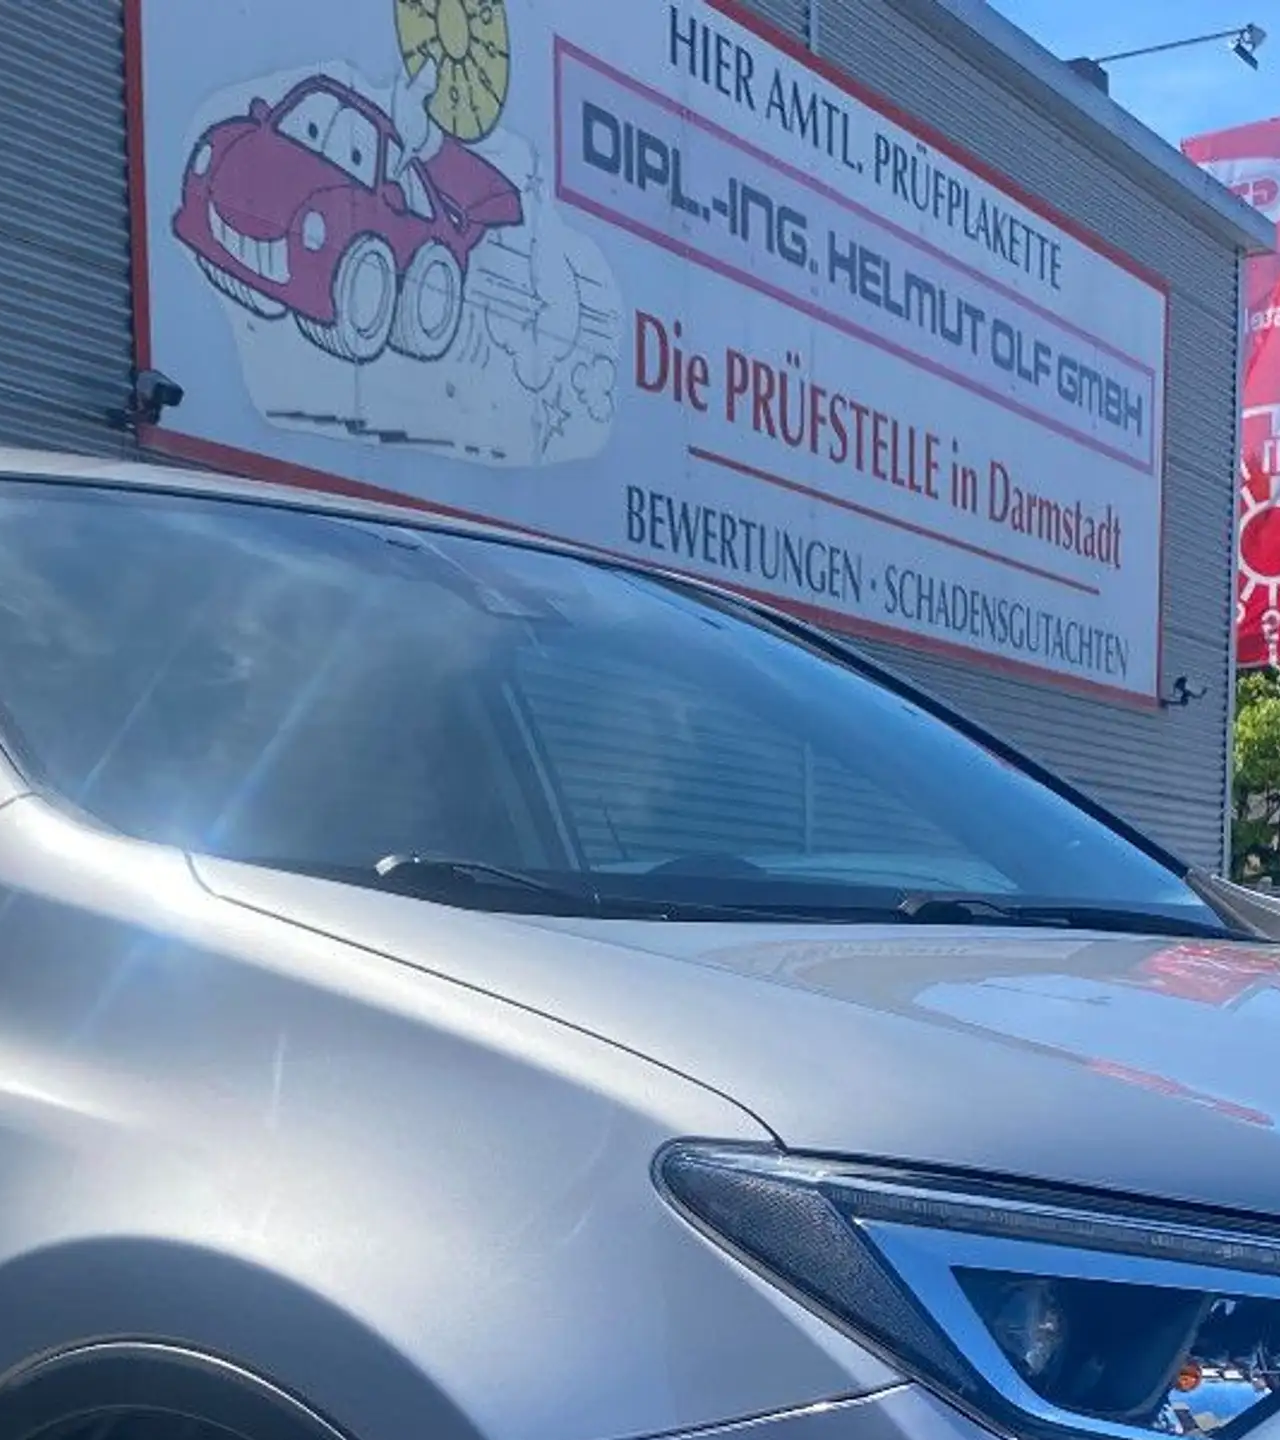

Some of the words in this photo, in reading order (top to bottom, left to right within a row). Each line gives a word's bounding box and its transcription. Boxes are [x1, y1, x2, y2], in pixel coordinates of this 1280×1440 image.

[582, 100, 818, 275] DIPL.-ING.
[827, 230, 985, 354] HELMUT
[991, 318, 1051, 386] OLF
[670, 5, 756, 111] HIER
[765, 67, 862, 174] AMTL.
[874, 136, 1062, 291] PRÜFPLAKETTE
[634, 309, 709, 412] Die
[726, 346, 940, 500] PRÜFSTELLE
[952, 436, 977, 514] in
[989, 459, 1121, 570] Darmstadt
[626, 485, 862, 602] BEWERTUNGEN
[884, 564, 1130, 680] SCHADENSGUTACHTEN
